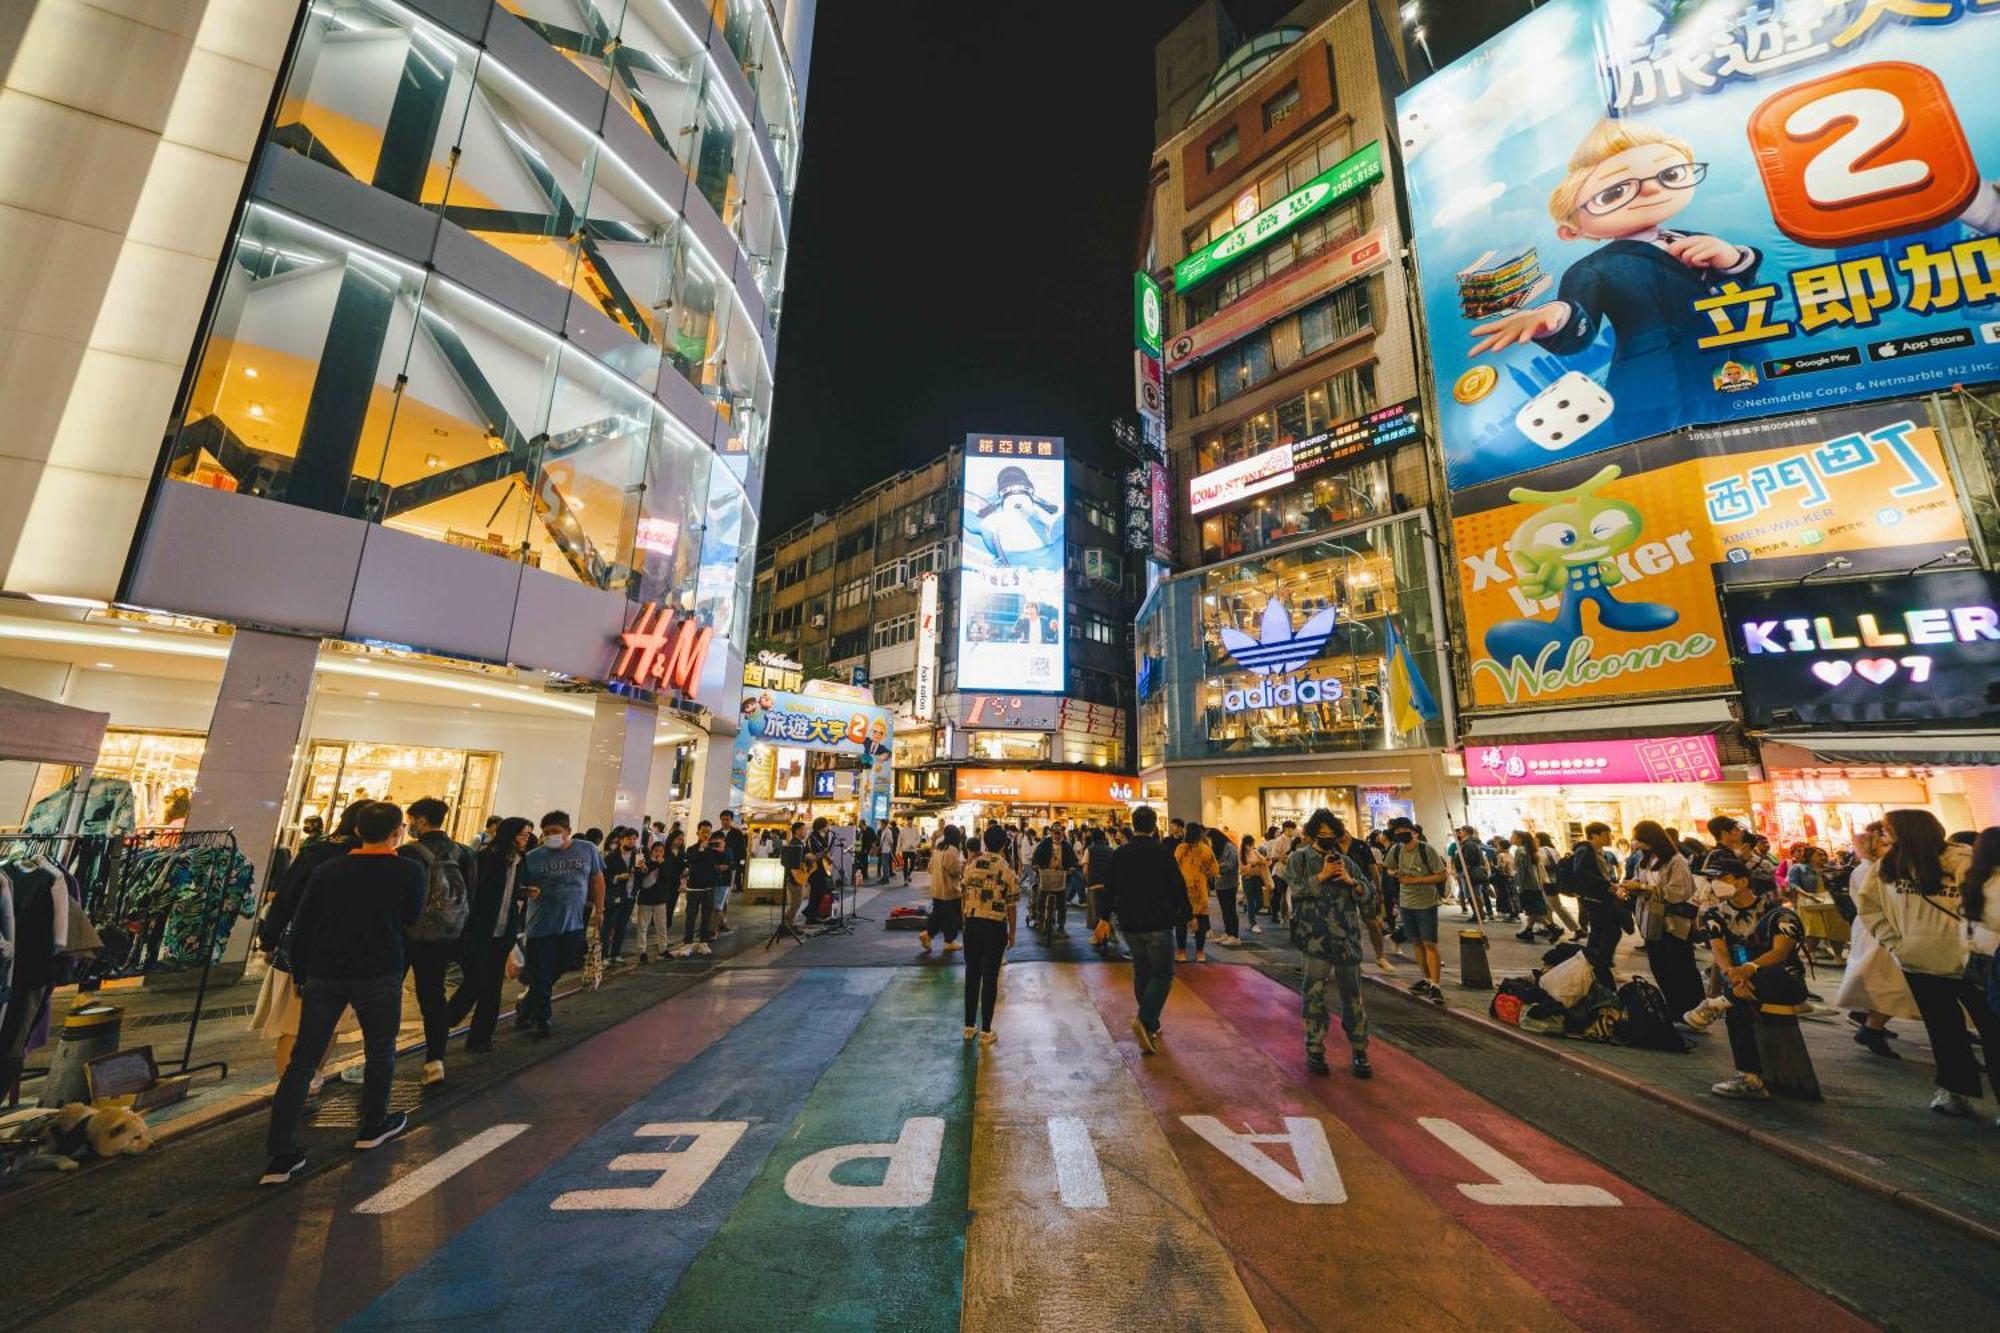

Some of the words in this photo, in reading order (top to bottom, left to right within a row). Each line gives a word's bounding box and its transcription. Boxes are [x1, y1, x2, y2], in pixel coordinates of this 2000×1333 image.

[1784, 88, 1931, 204] 2
[1695, 236, 2000, 349] 立即加
[1795, 356, 1829, 369] Google
[1831, 353, 1851, 365] Play
[1902, 340, 1929, 352] App
[1930, 333, 1965, 348] Store
[1816, 384, 1851, 398] Corp.
[1855, 381, 1866, 391] &
[1869, 369, 1944, 389] Netmarble
[1948, 366, 1967, 376] N2
[1971, 361, 1999, 374] Inc.
[1722, 528, 1769, 546] XIMEN
[1771, 508, 1836, 534] WALKER
[1742, 606, 2000, 655] KILLER
[622, 601, 713, 699] H&M
[1472, 633, 1716, 703] Welcome
[1901, 655, 1931, 683] 7
[1224, 676, 1343, 712] adidas
[763, 710, 847, 744] 旅遊大亨
